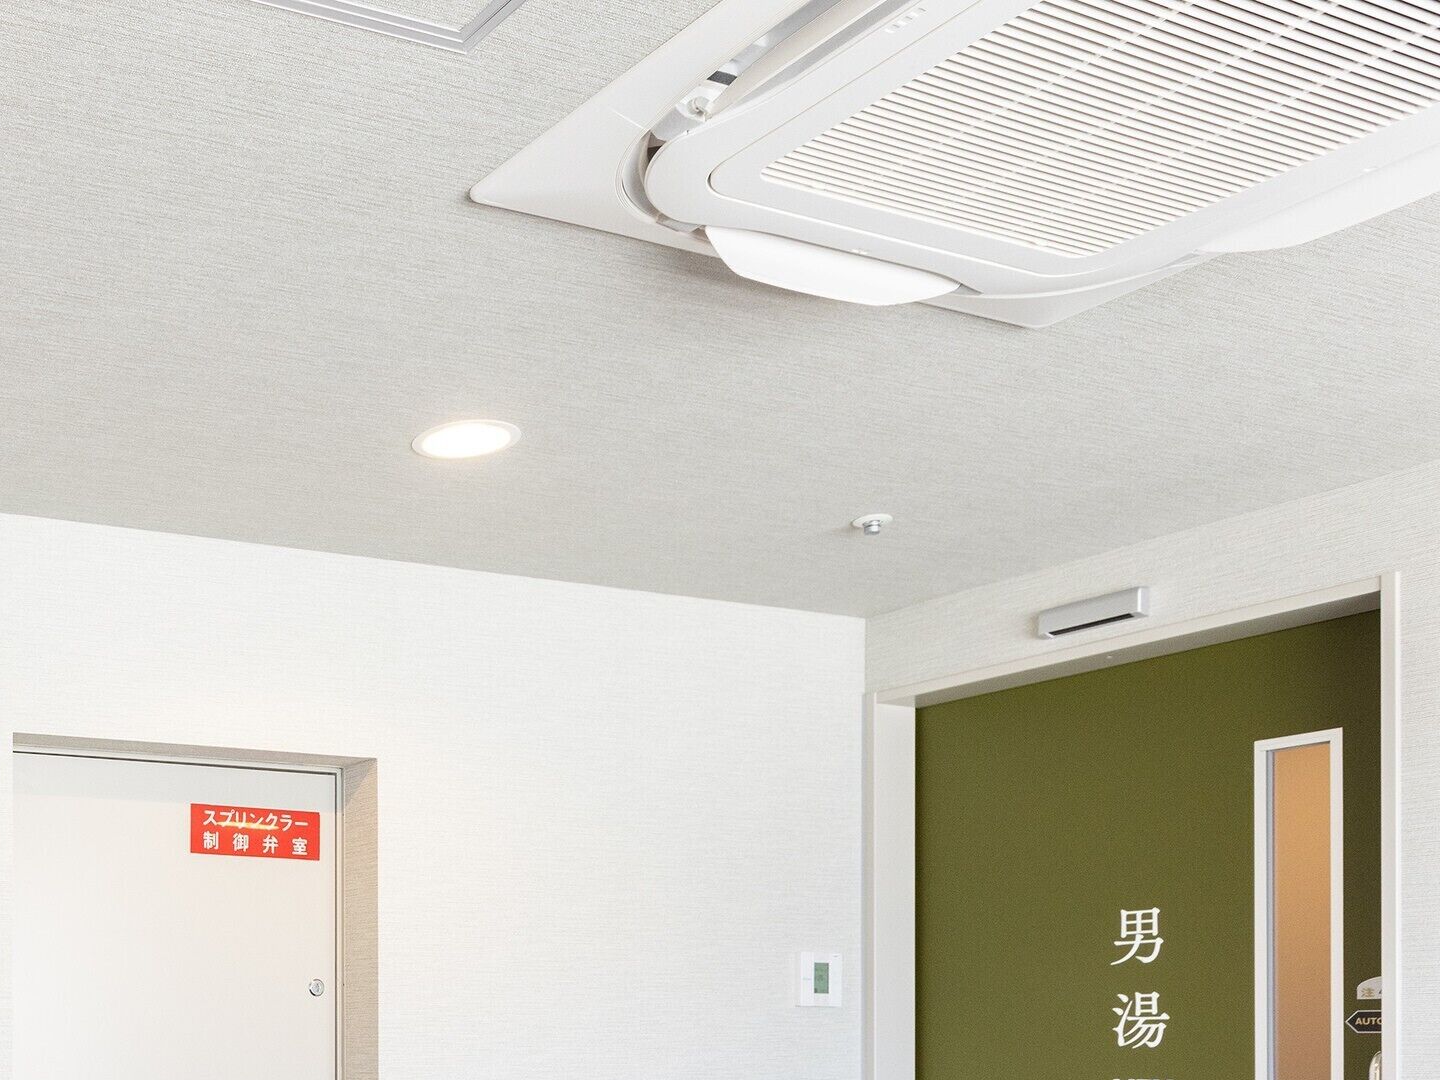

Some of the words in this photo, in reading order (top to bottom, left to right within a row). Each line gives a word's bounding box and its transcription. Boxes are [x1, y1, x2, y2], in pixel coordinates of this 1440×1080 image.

[203, 809, 308, 832] スプリンクラー
[1110, 906, 1171, 1049] 男湯
